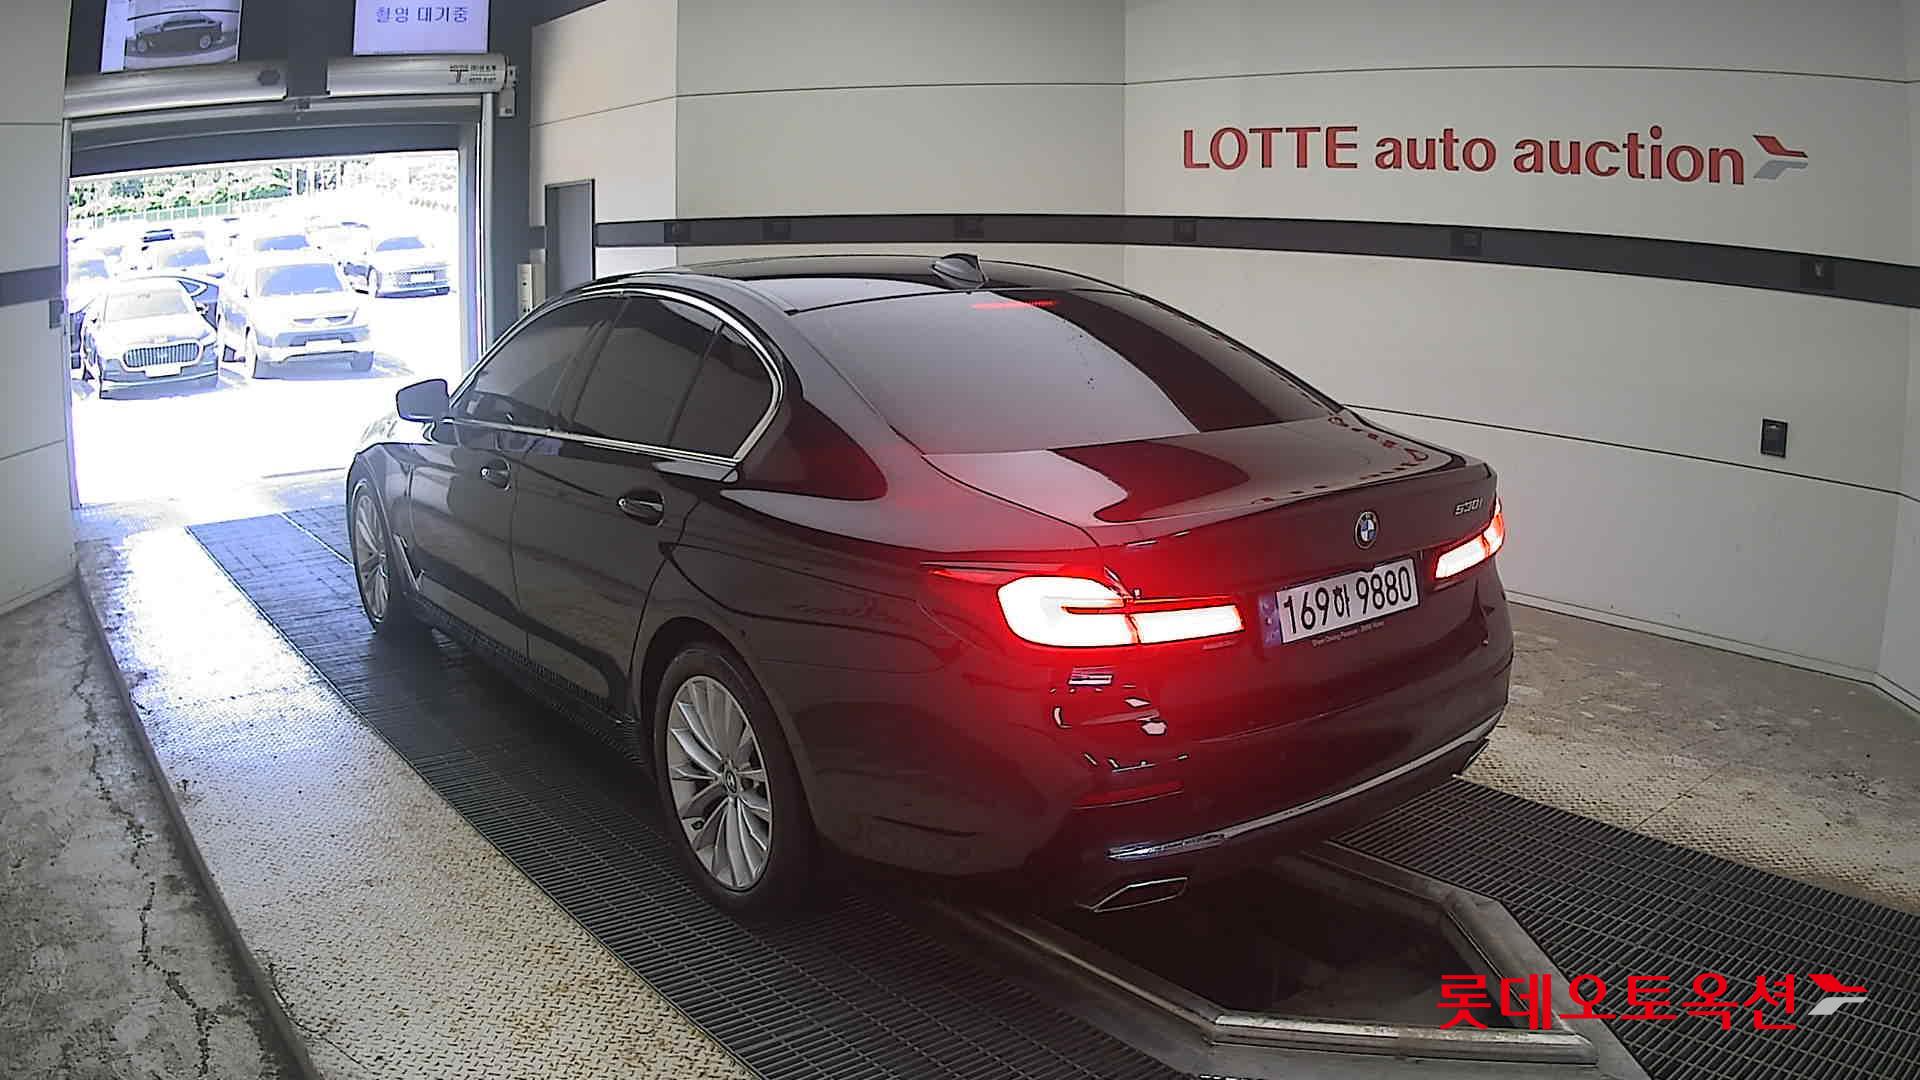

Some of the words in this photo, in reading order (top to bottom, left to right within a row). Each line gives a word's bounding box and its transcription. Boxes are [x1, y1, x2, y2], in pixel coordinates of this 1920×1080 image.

[417, 7, 469, 23] 대기중
[1182, 126, 1359, 170] LOTTE
[1374, 127, 1497, 173] auto
[1512, 125, 1745, 186] auction
[1455, 497, 1483, 516] 530i
[1283, 583, 1351, 634] 169하
[1355, 566, 1412, 615] 9880
